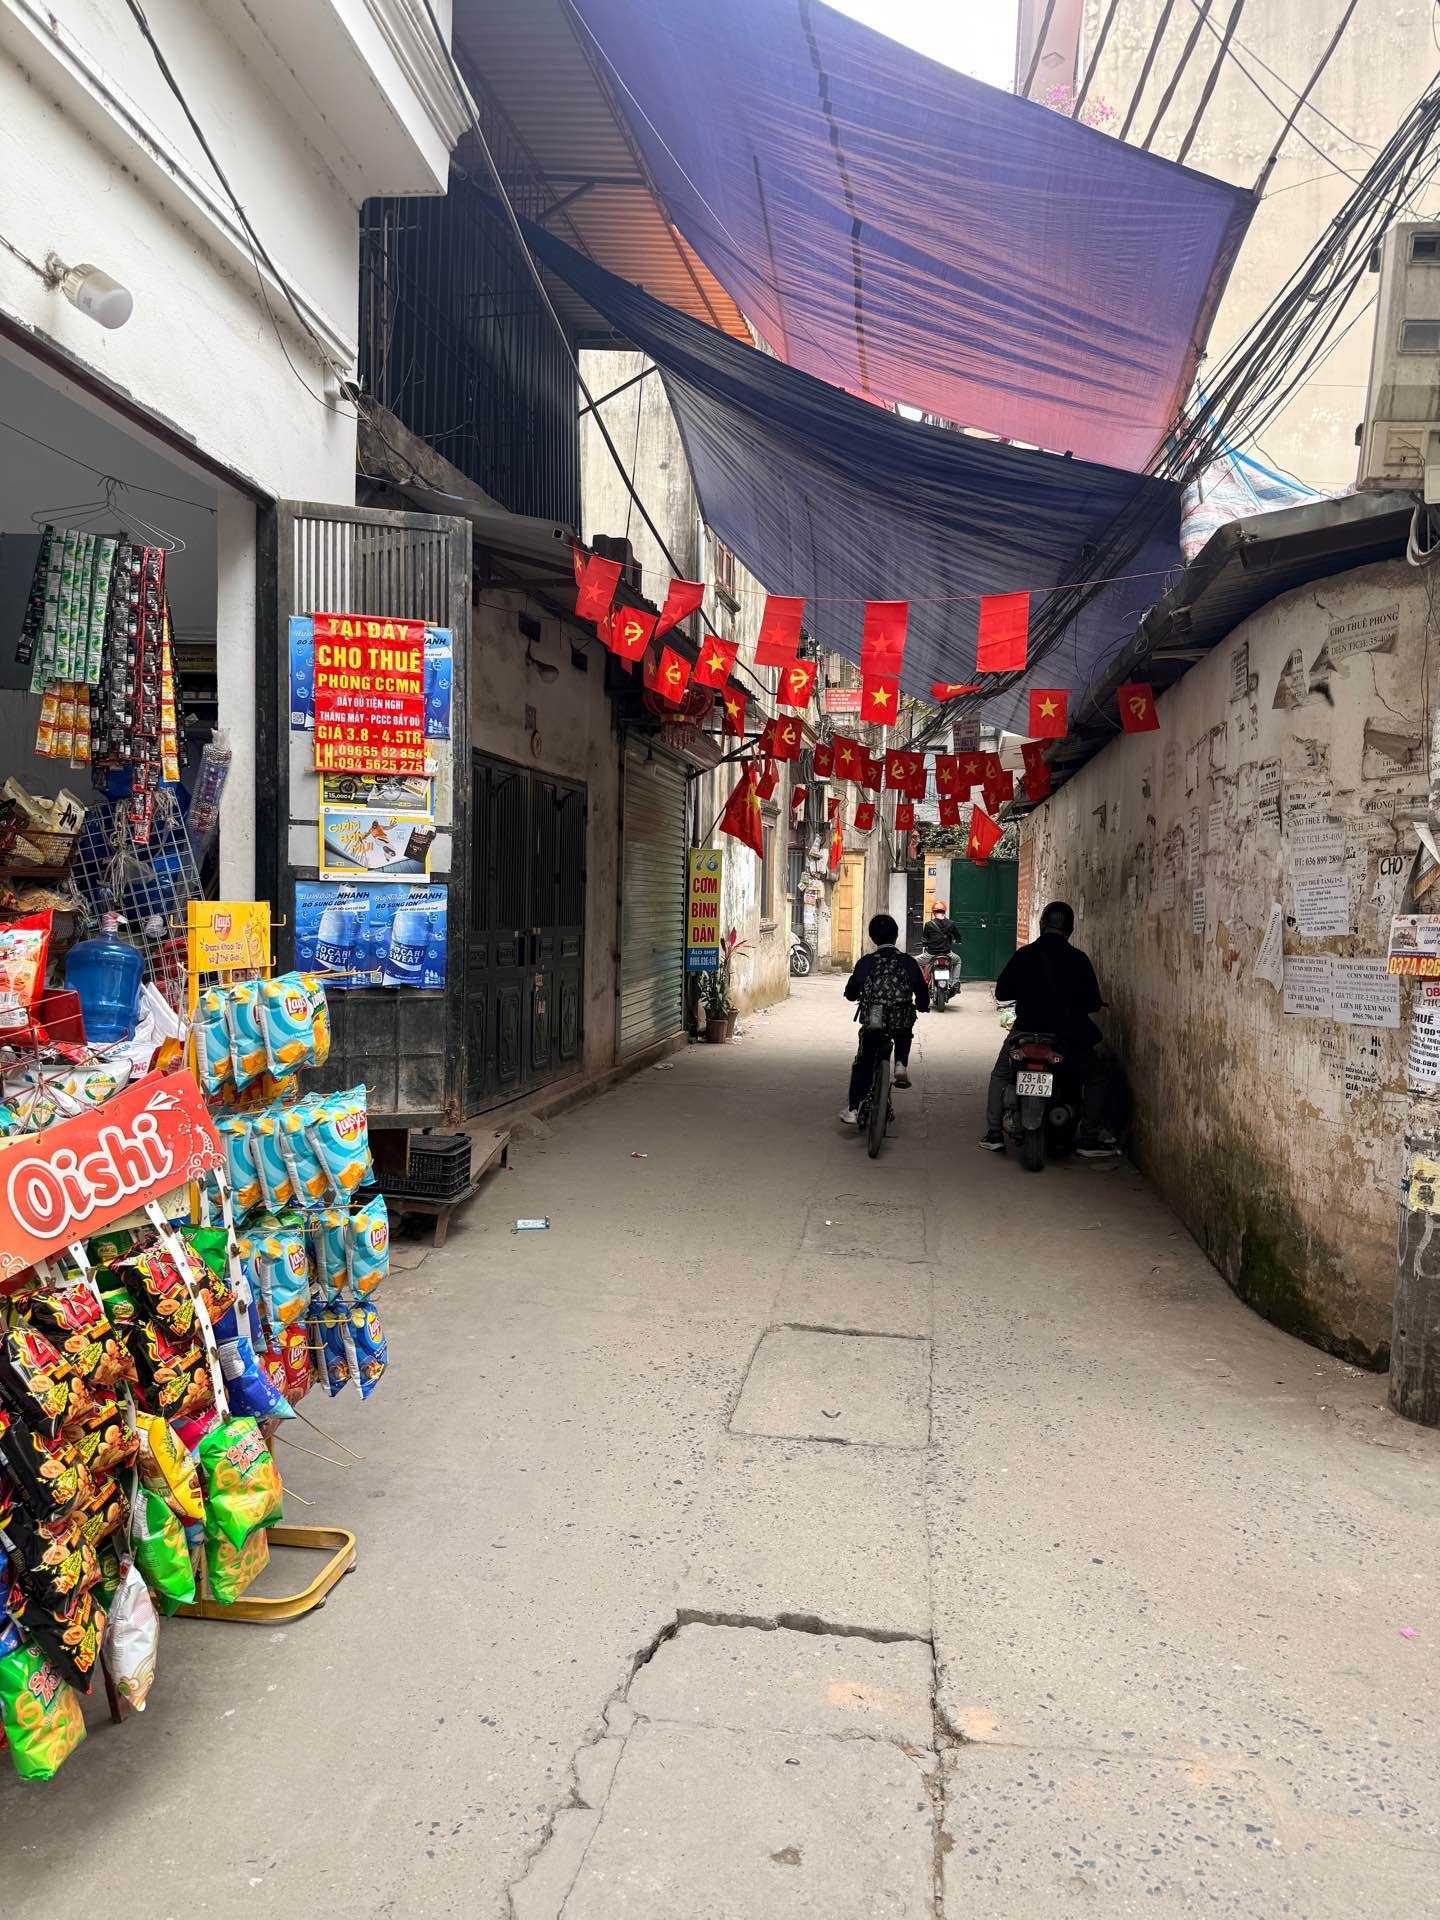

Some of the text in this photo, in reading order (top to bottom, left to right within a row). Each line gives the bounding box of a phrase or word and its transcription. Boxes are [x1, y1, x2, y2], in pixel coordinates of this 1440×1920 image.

[328, 619, 409, 641] TẠI ĐÂY
[318, 645, 421, 673] CHO THUÊ
[318, 672, 420, 694] PHÒNG CCMN
[366, 697, 383, 710] TIỆN
[384, 699, 404, 710] NGHI
[370, 714, 392, 724] PCCC
[318, 724, 343, 740] GIÁ
[346, 727, 369, 742] 3.8
[382, 730, 422, 744] 4.5TR
[339, 758, 423, 772] 094 5625 275
[693, 877, 718, 894] CƠM
[408, 892, 442, 900] NHANH
[692, 899, 717, 918] BÌNH
[692, 924, 715, 944] DÂN
[204, 942, 220, 952] Snack
[316, 942, 351, 958] POCARI
[390, 942, 424, 957] POCARI
[316, 951, 348, 964] SWEAT
[390, 951, 420, 964] SWEAT
[287, 997, 308, 1014] Lay's
[1018, 1084, 1050, 1095] 027.97
[8, 1113, 174, 1238] Oishi
[372, 1226, 388, 1246] Lay's
[289, 1248, 305, 1270] Lay's
